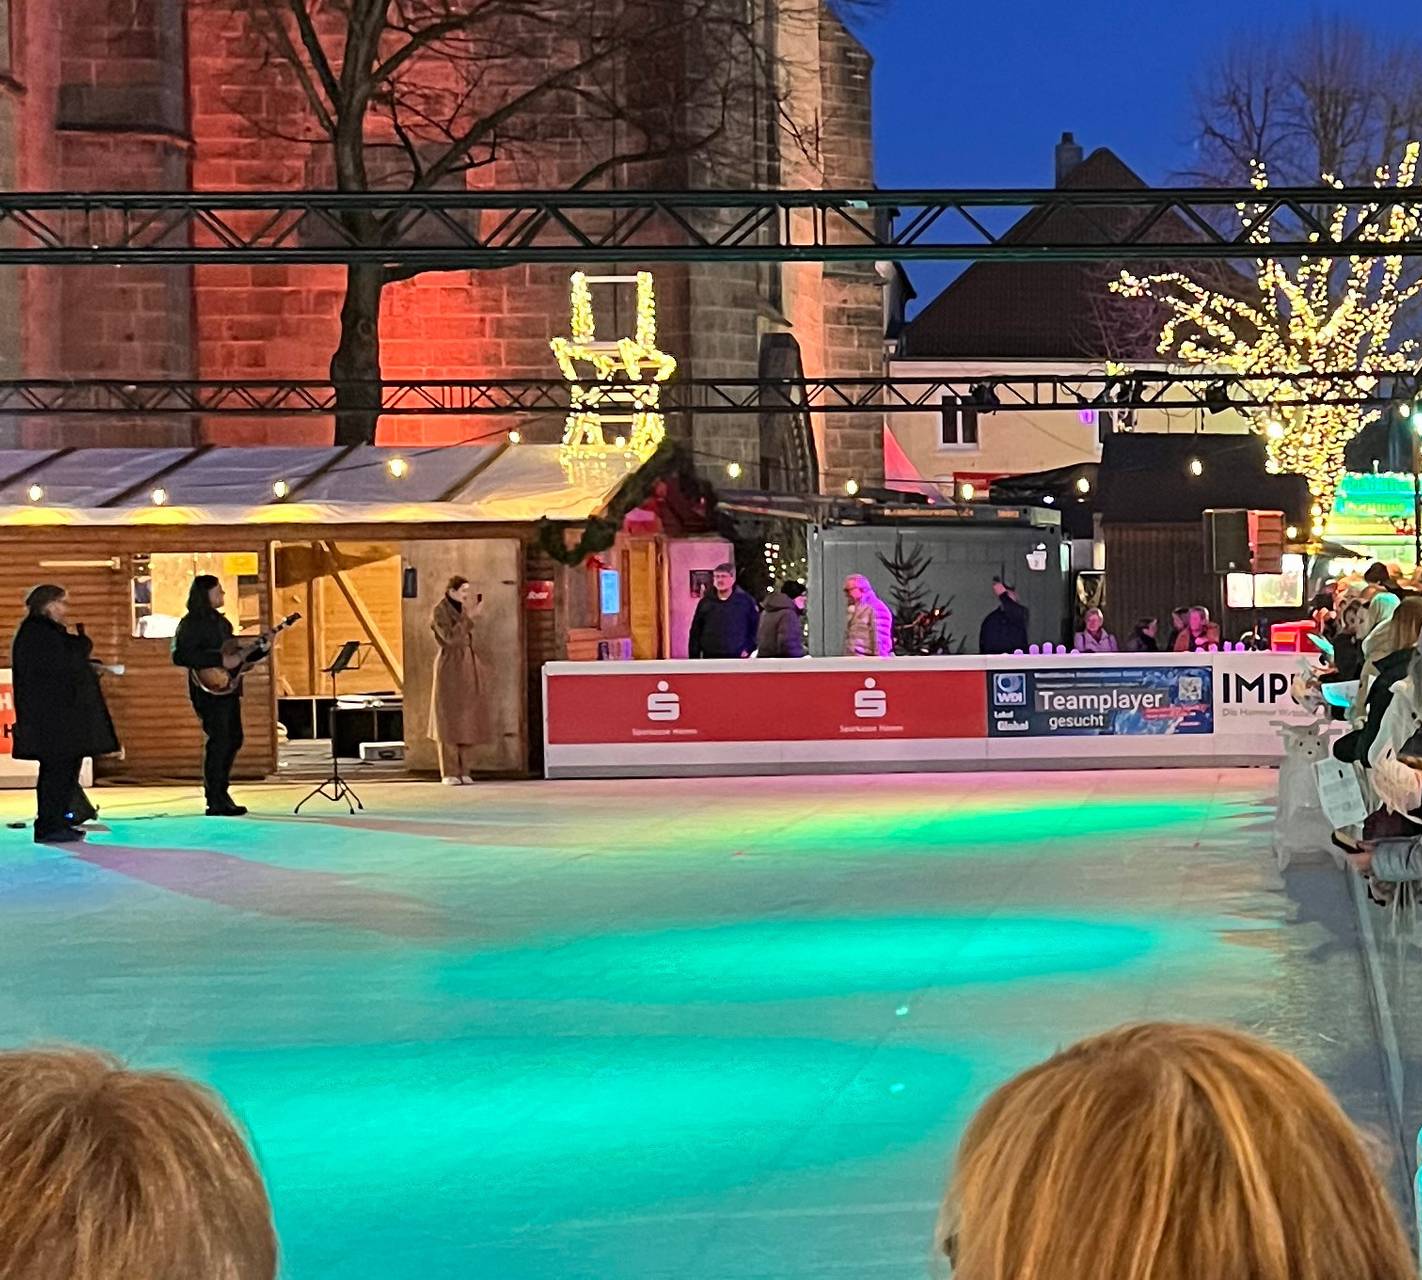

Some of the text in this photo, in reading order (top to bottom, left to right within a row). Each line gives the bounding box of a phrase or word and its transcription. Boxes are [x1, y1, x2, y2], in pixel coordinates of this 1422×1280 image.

[997, 692, 1023, 703] WDI
[1038, 689, 1164, 715] Teamplayer
[1048, 713, 1105, 731] gesucht
